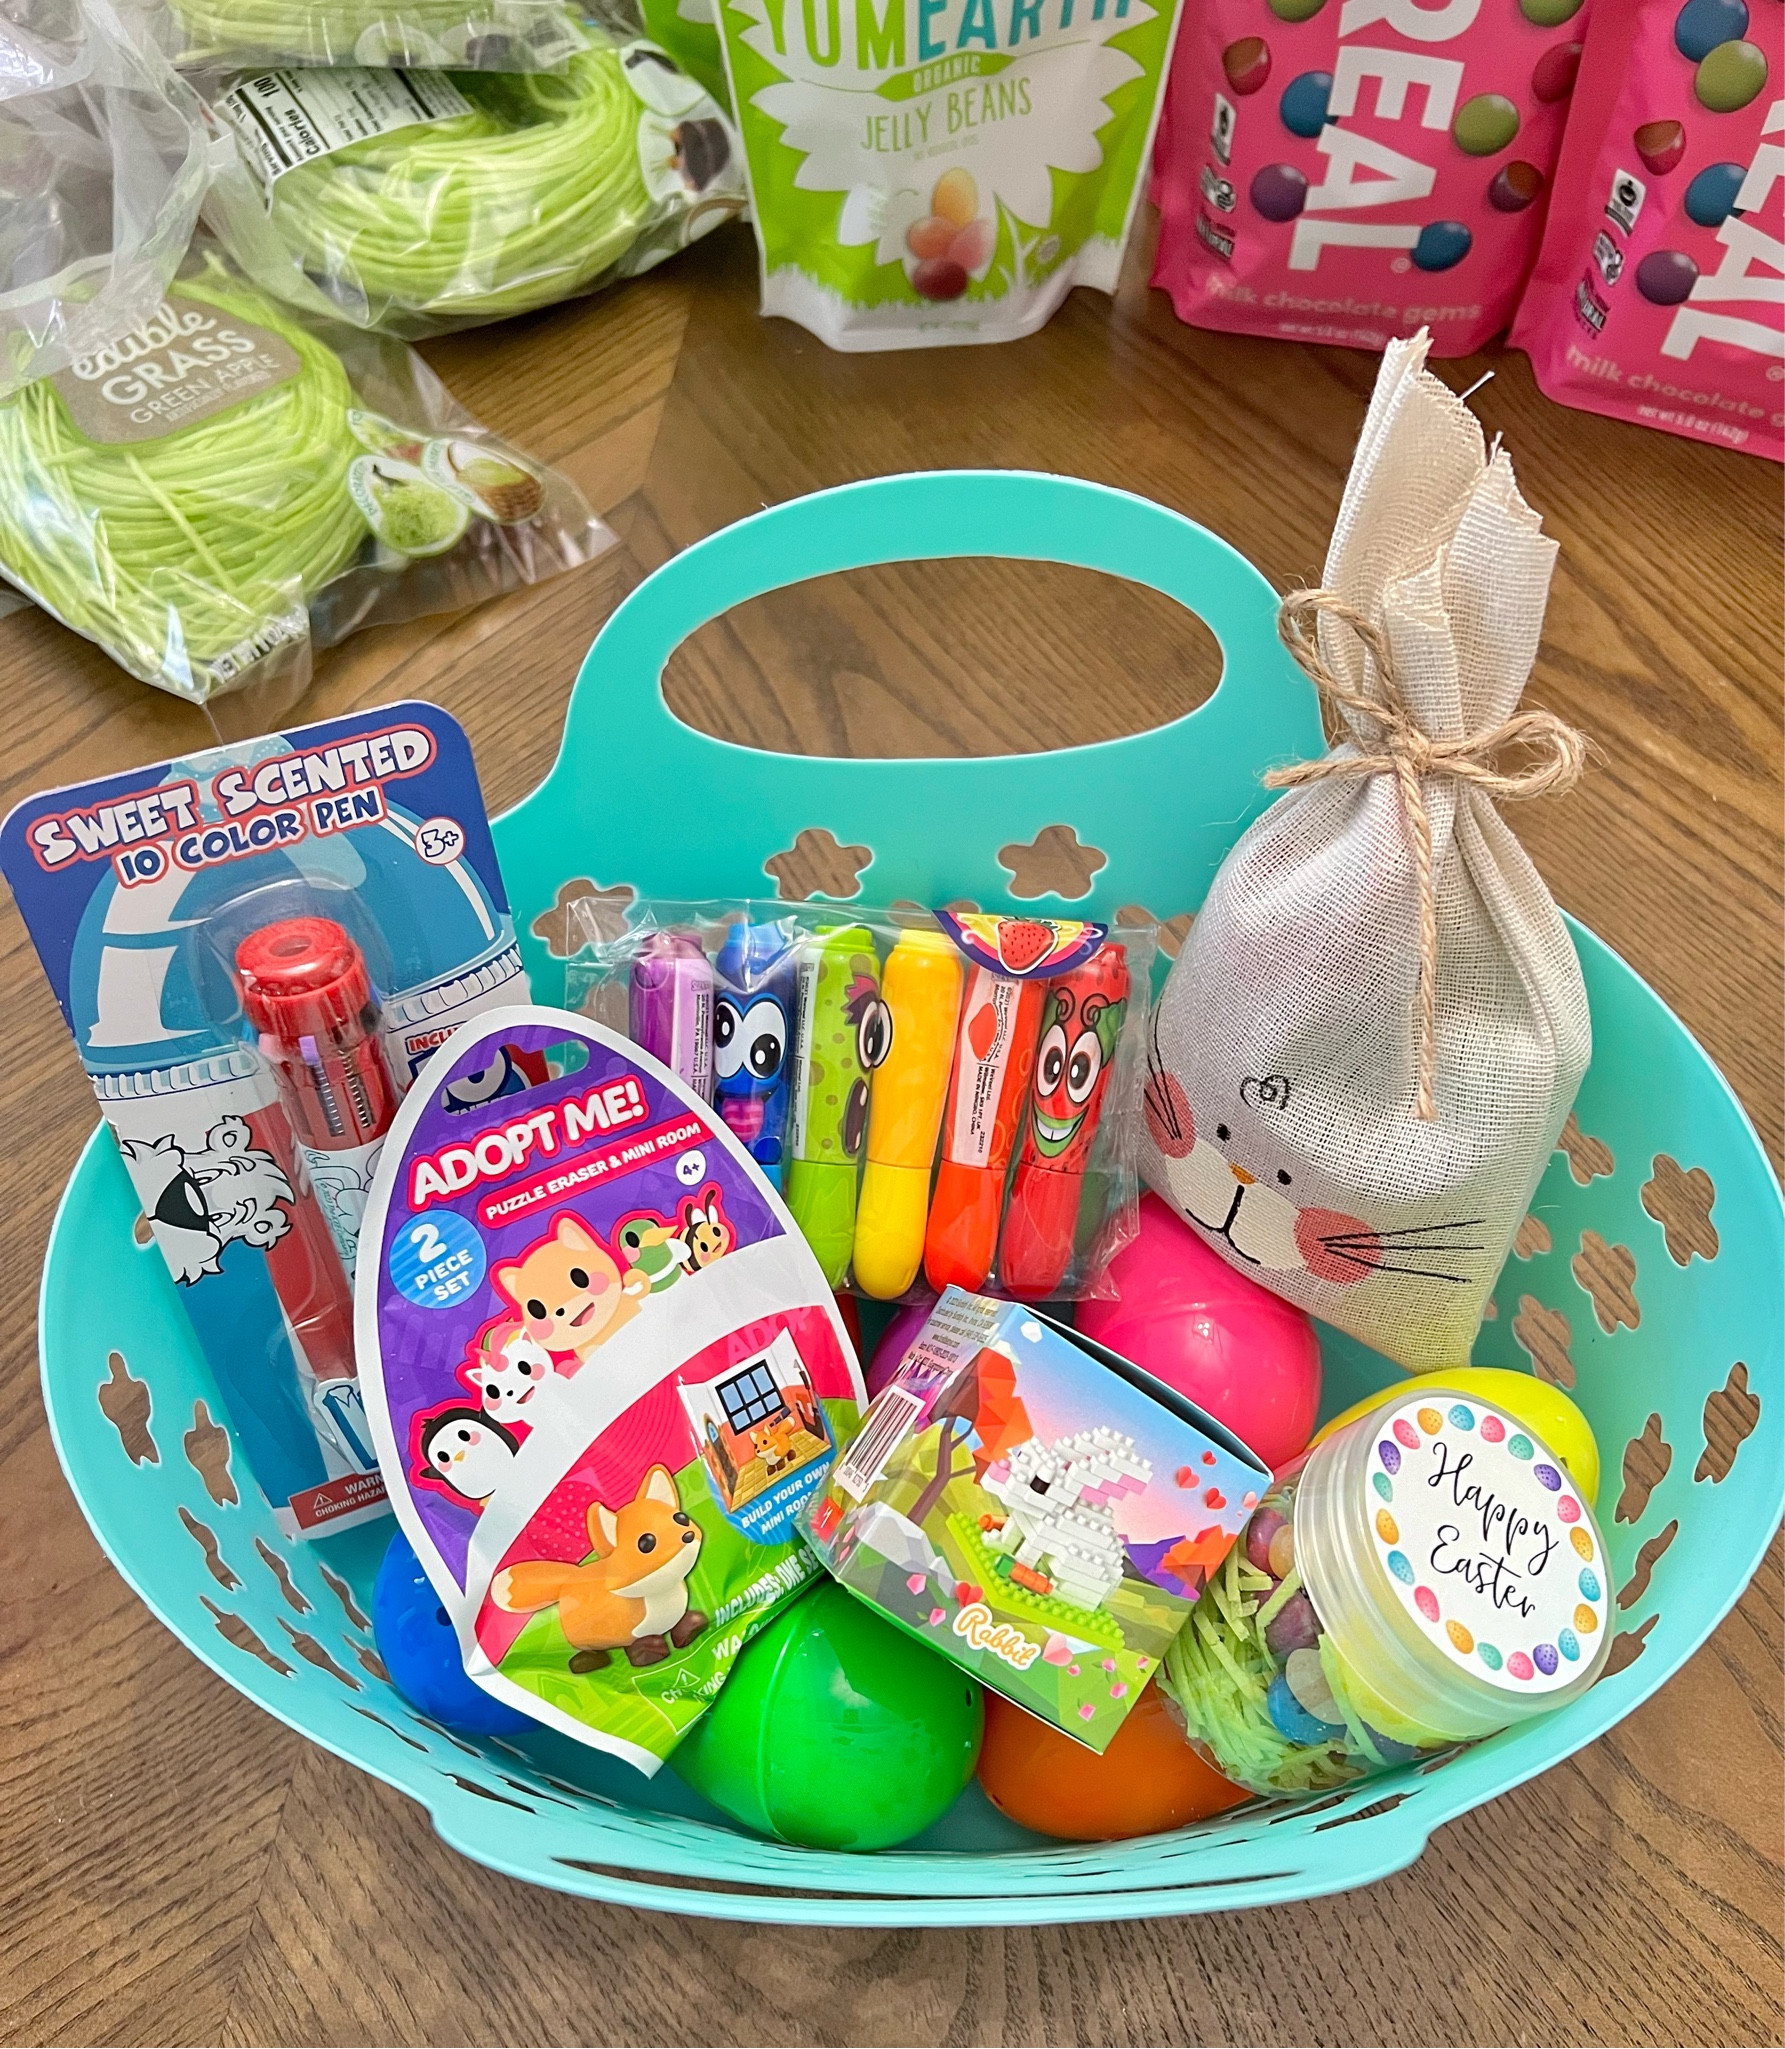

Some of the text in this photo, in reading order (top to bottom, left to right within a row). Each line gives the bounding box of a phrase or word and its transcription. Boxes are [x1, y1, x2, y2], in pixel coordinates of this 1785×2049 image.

[913, 55, 982, 94] ORGANIC
[253, 77, 321, 156] Calories 100
[861, 103, 932, 153] JELLY
[948, 77, 1032, 135] BEANS
[1263, 291, 1397, 318] chocolate
[1402, 304, 1481, 324] gems
[102, 330, 256, 405] GRASS
[130, 378, 212, 424] GREEN
[215, 353, 280, 384] APPLE
[1565, 345, 1765, 419] milk chocolate
[33, 730, 429, 865] SWEET SCENTED
[178, 810, 302, 866] COLOR
[314, 789, 382, 830] PEN
[421, 828, 459, 858] 3+
[408, 1027, 459, 1052] INCL
[414, 1081, 645, 1205] ADOPT ME!
[486, 1122, 701, 1221] PUZZLE ERASER & MINI ROOM
[683, 1163, 700, 1176] 4+
[410, 1223, 447, 1263] 2
[414, 1249, 473, 1290] PIECE
[434, 1270, 470, 1301] SET
[315, 1486, 386, 1518] CHOKING HAZA
[345, 1474, 384, 1495] WARN
[741, 1500, 773, 1529] BUILD
[773, 1479, 804, 1504] YOUR
[804, 1461, 830, 1484] OWN
[761, 1492, 812, 1535] MINI ROO
[1428, 1441, 1560, 1576] Happy
[774, 1555, 807, 1591] ONE
[798, 1544, 819, 1575] SE
[1430, 1524, 1536, 1618] Easter
[955, 1608, 1037, 1666] Rabbit
